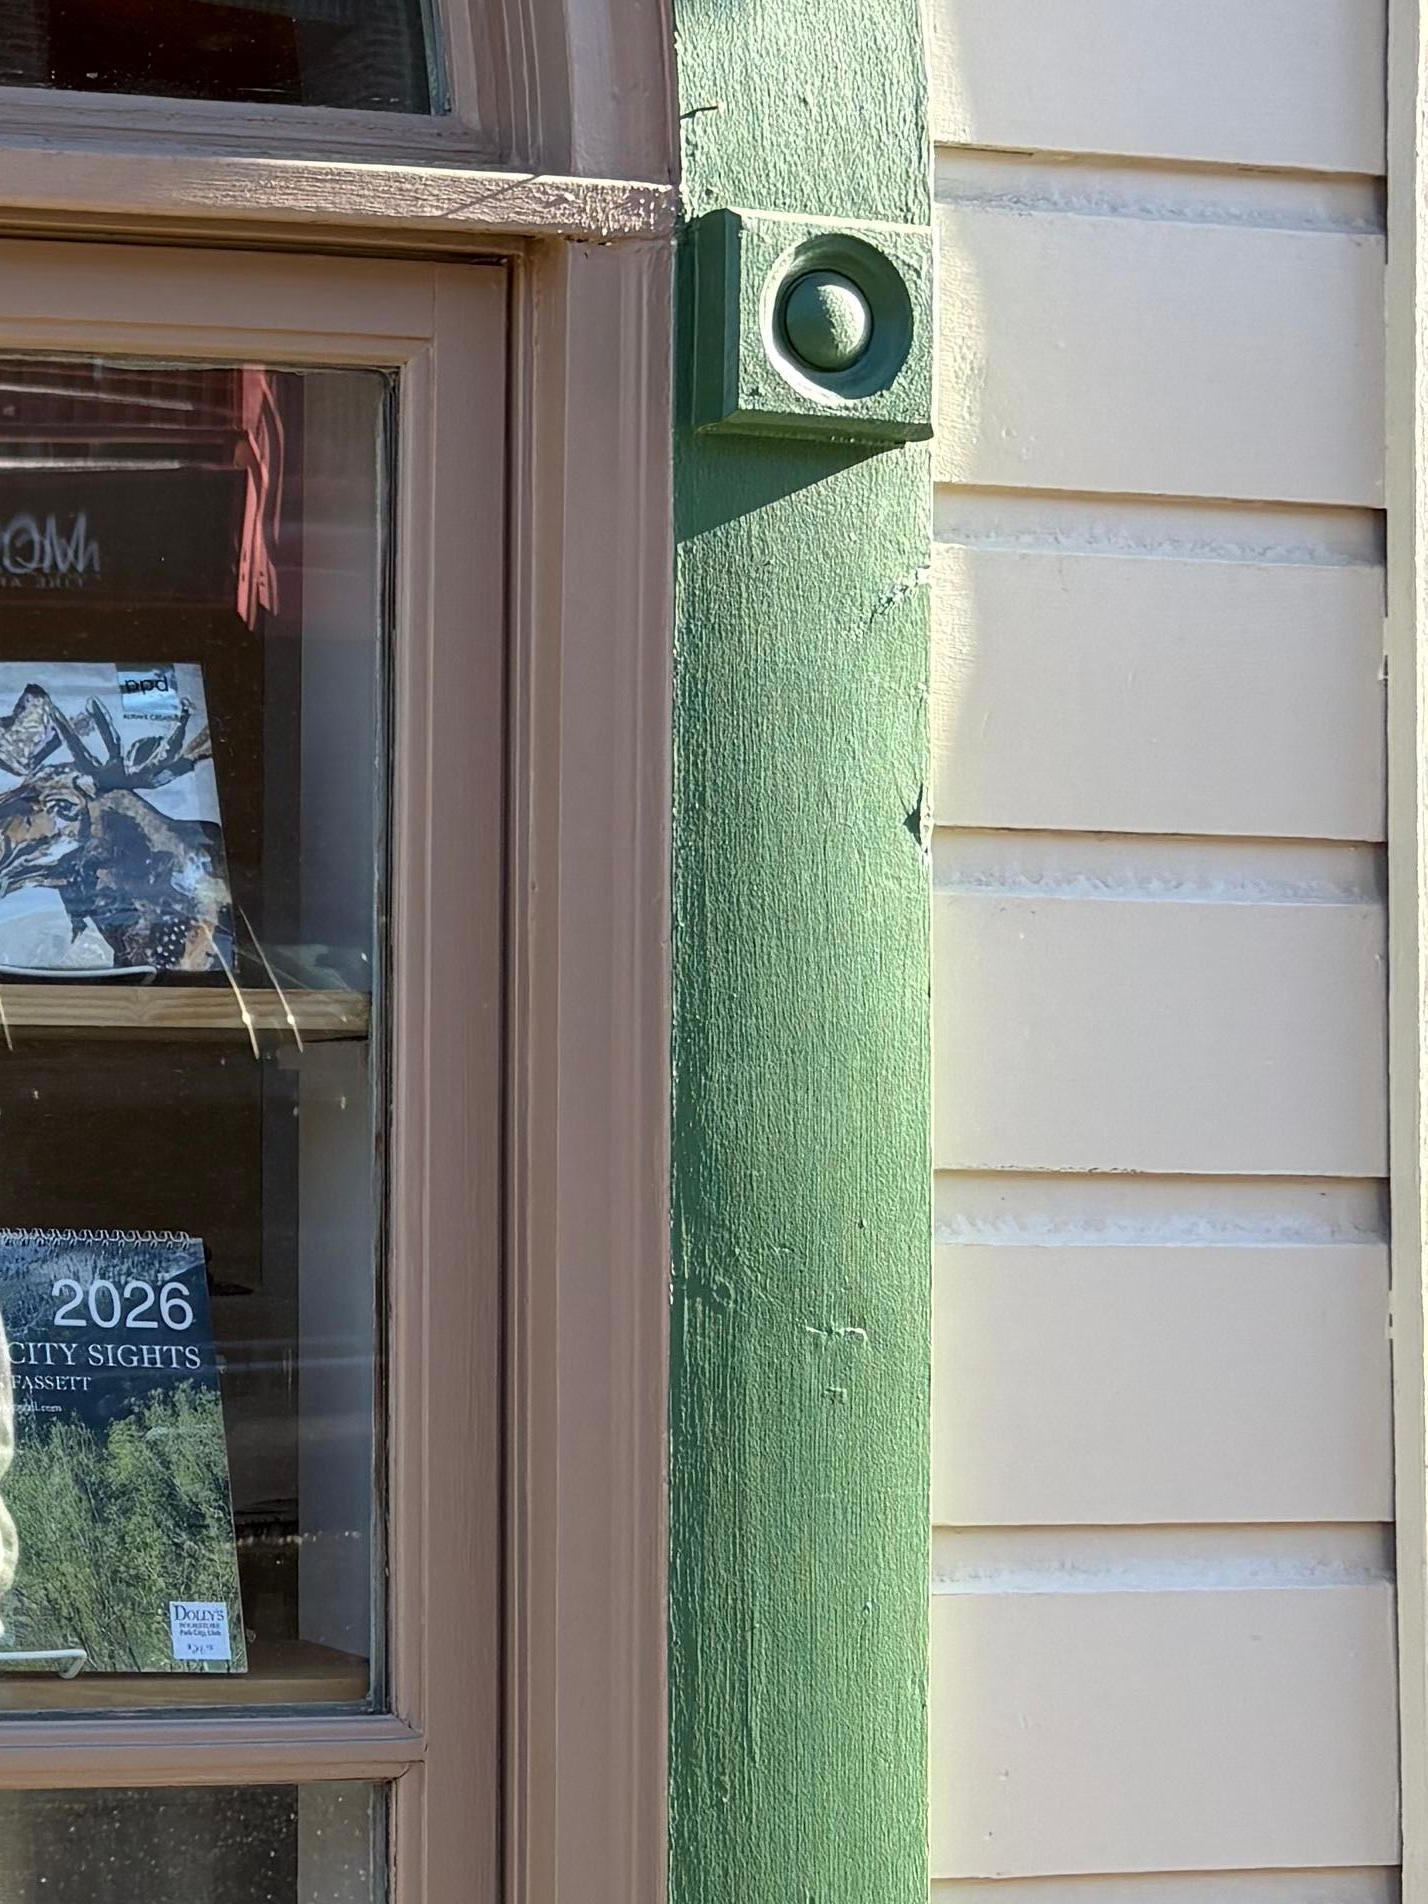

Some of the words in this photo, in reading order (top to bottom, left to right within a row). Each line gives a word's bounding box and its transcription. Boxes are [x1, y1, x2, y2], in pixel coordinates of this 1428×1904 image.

[52, 1278, 194, 1331] 2026
[7, 1342, 79, 1366] CITY
[88, 1344, 202, 1369] SIGHTS
[12, 1374, 92, 1392] FASSETT
